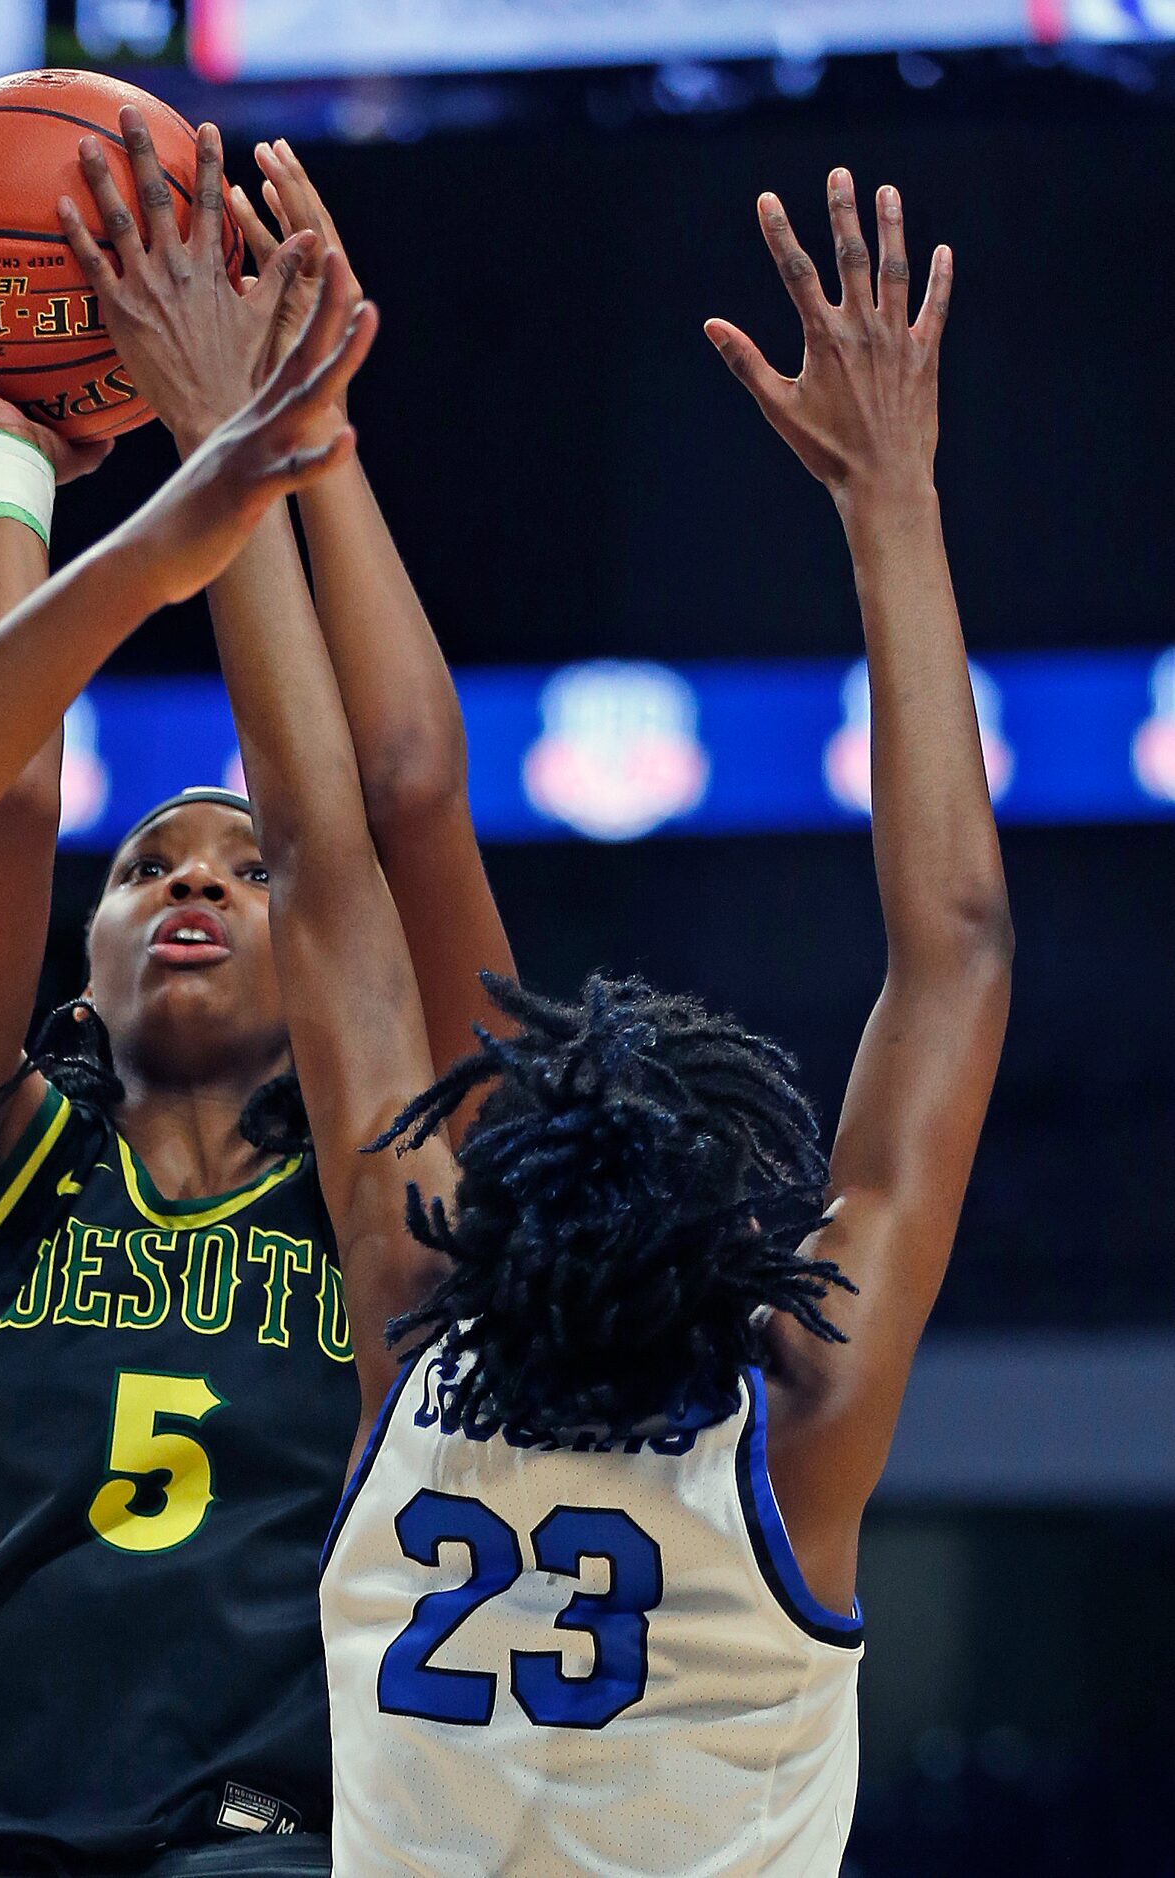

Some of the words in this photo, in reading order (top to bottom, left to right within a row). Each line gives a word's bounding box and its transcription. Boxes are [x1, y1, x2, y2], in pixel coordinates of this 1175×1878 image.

[27, 255, 65, 268] DEEP
[85, 1367, 232, 1555] 5
[376, 1487, 664, 1730] 23
[276, 1817, 296, 1835] M
